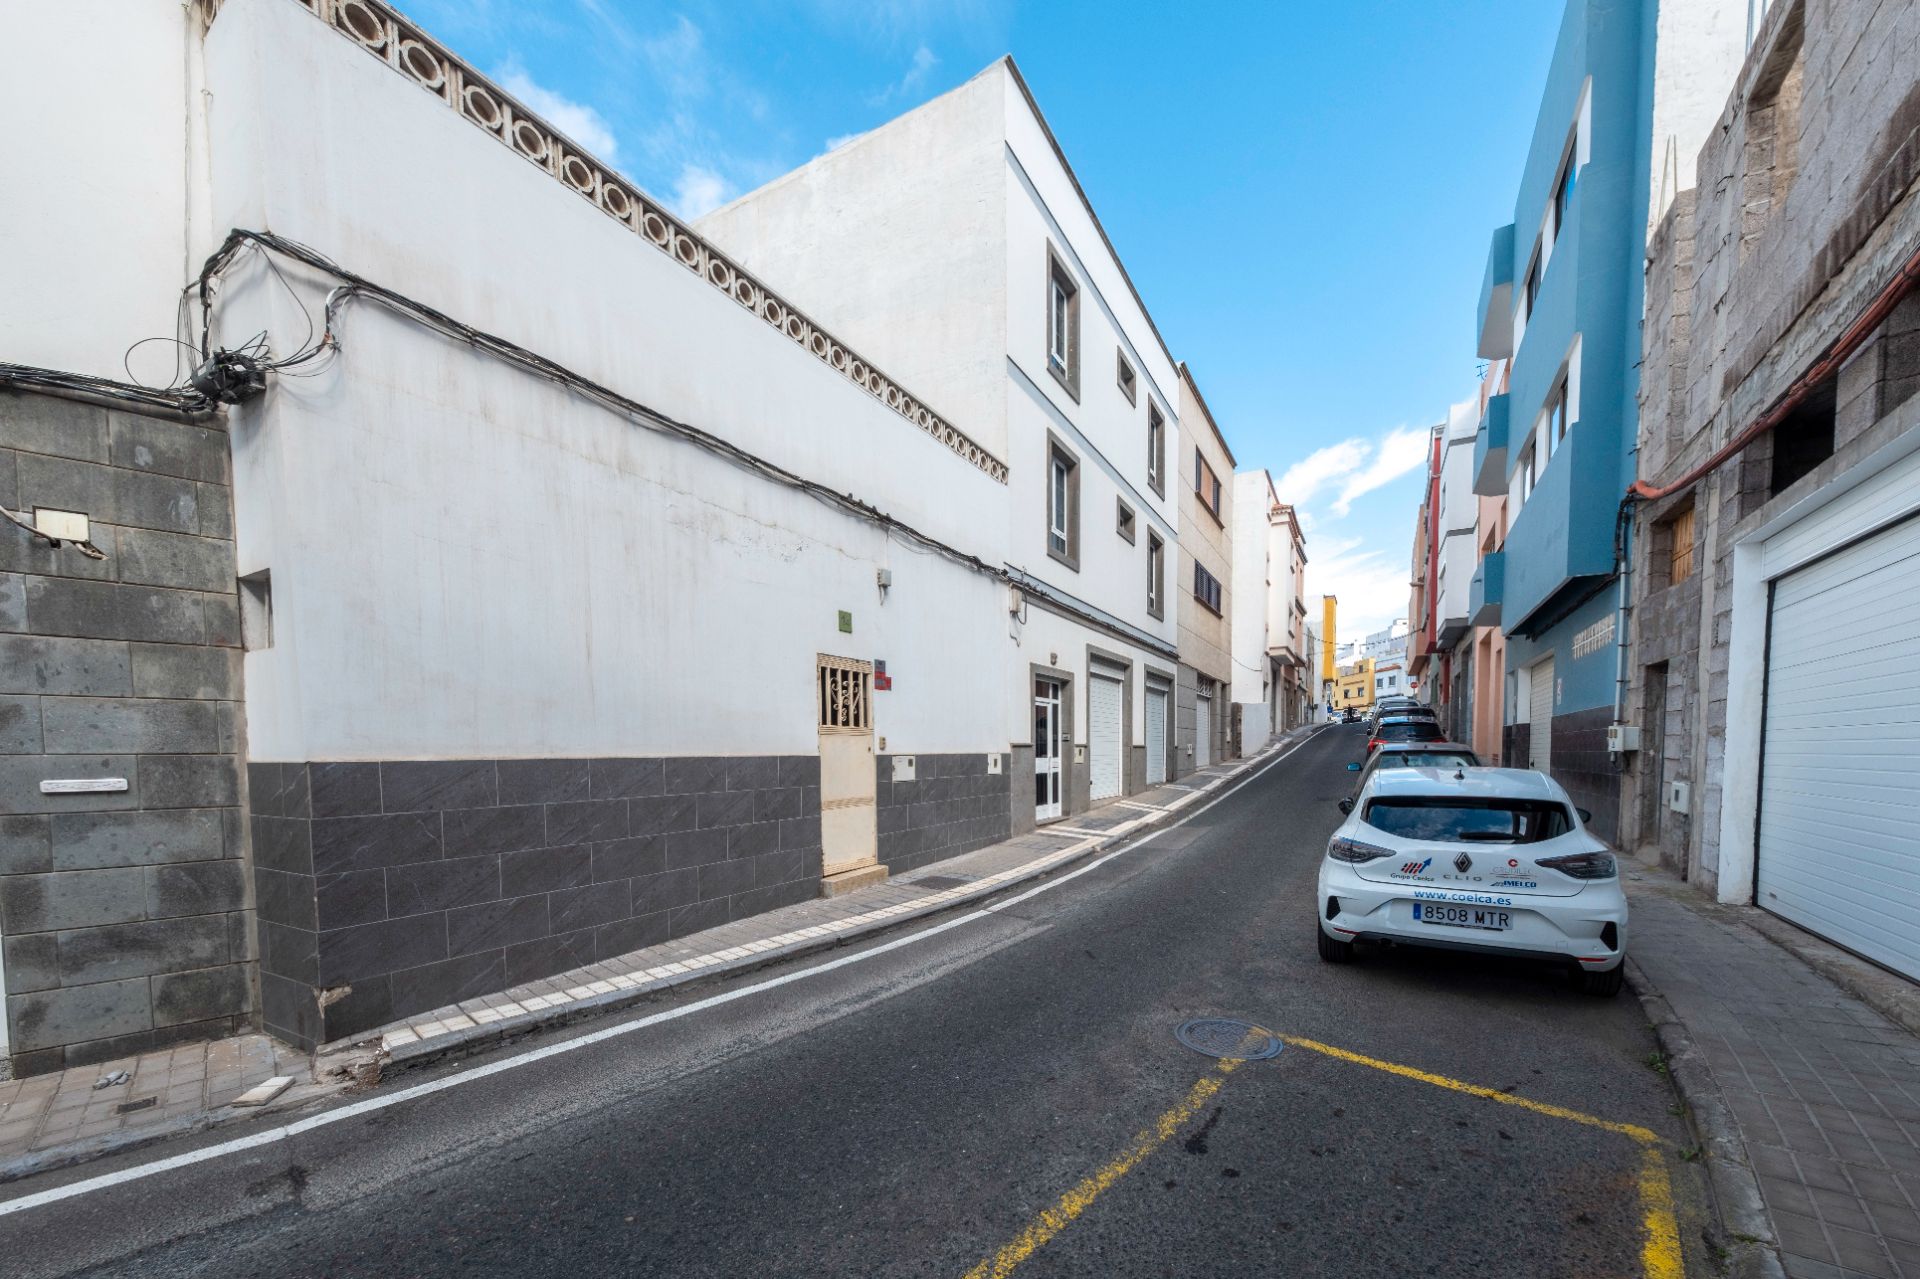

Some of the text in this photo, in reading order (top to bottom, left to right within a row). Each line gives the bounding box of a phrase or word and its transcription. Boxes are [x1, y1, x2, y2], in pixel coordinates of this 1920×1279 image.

[1443, 874, 1482, 882] CLIO
[1414, 890, 1512, 906] www.coelca.es
[1425, 906, 1468, 923] 8508
[1475, 910, 1510, 927] MTR
